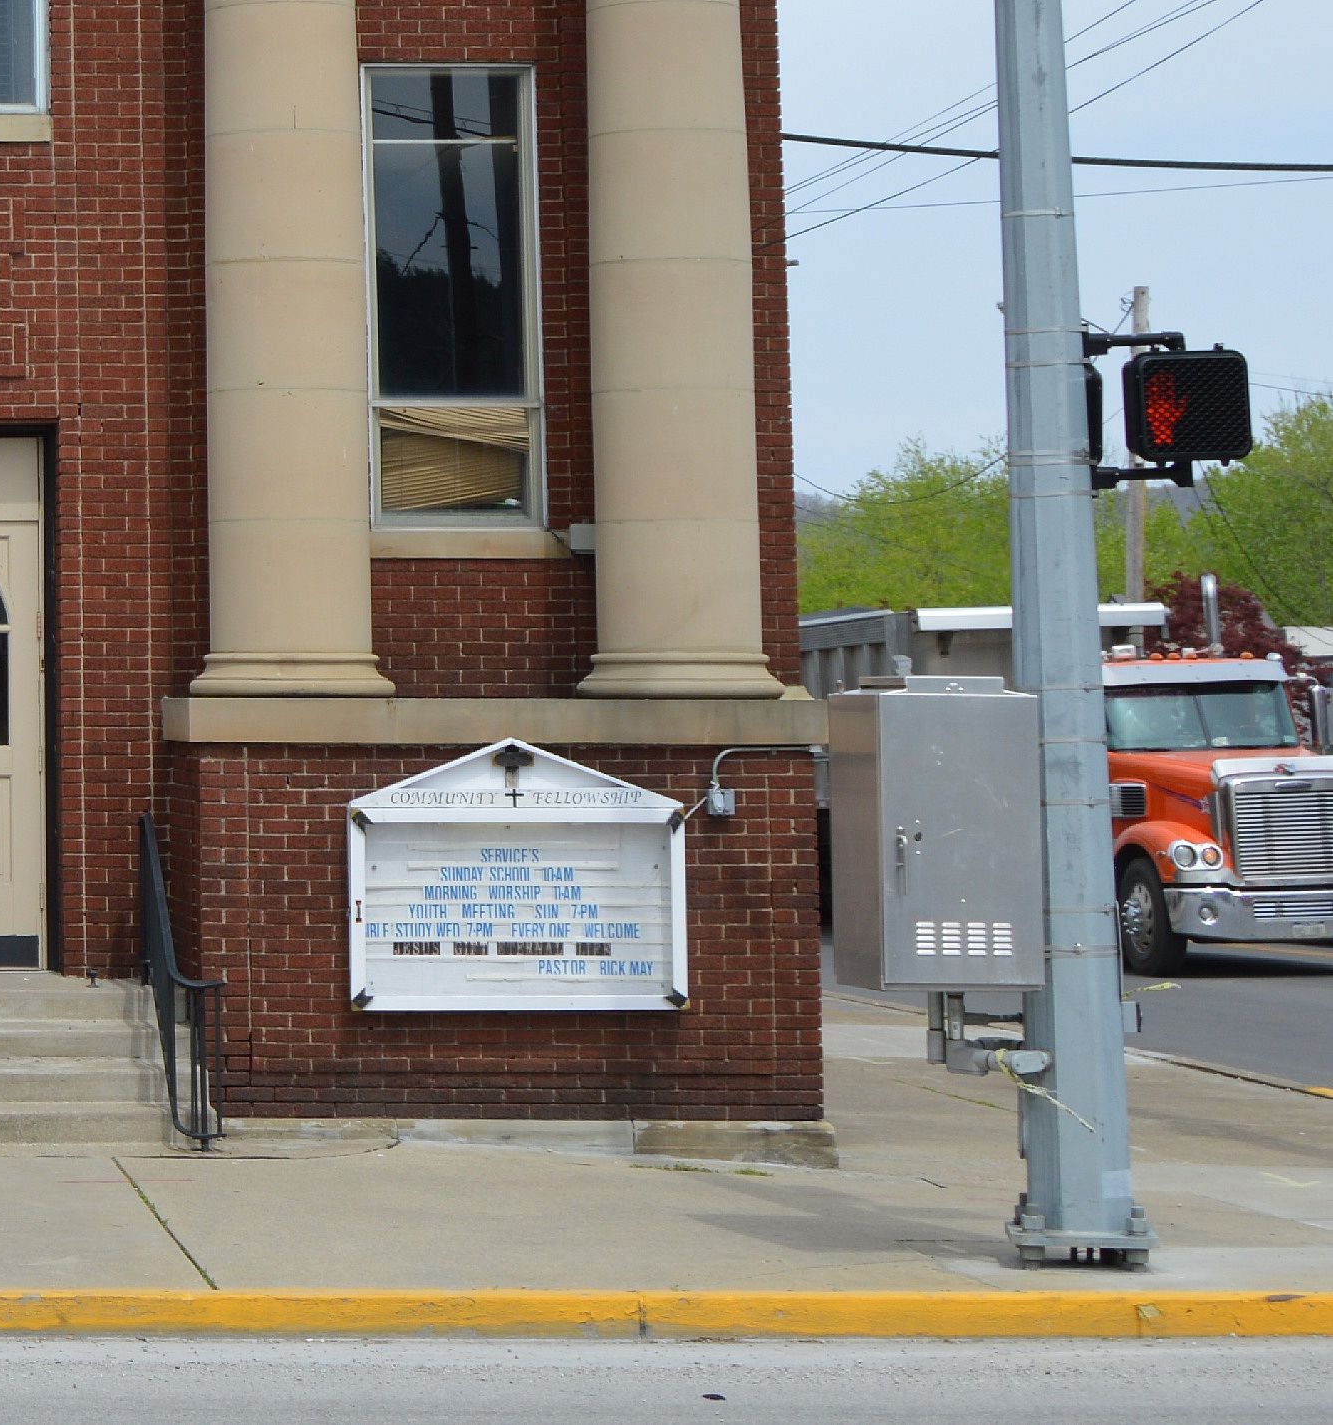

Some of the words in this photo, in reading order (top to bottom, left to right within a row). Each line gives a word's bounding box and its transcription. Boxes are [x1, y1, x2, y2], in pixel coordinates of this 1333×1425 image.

[390, 790, 498, 805] COMMUNITY
[532, 790, 642, 805] FELLOWSHIP
[440, 866, 484, 882] SUNDAY
[489, 866, 530, 882] SCHOOL
[424, 885, 477, 900] MORNING
[488, 885, 541, 900] WORSHIP
[409, 904, 447, 919] YOUTH
[461, 904, 516, 919] MEETING
[534, 904, 559, 919] SUN
[395, 922, 432, 938] STUDY
[436, 922, 460, 938] WED
[511, 922, 545, 938] EVERY
[584, 922, 640, 938] WELCOME
[393, 941, 441, 956] JESUS
[538, 959, 587, 976] PASTOR
[629, 959, 654, 976] MAY
